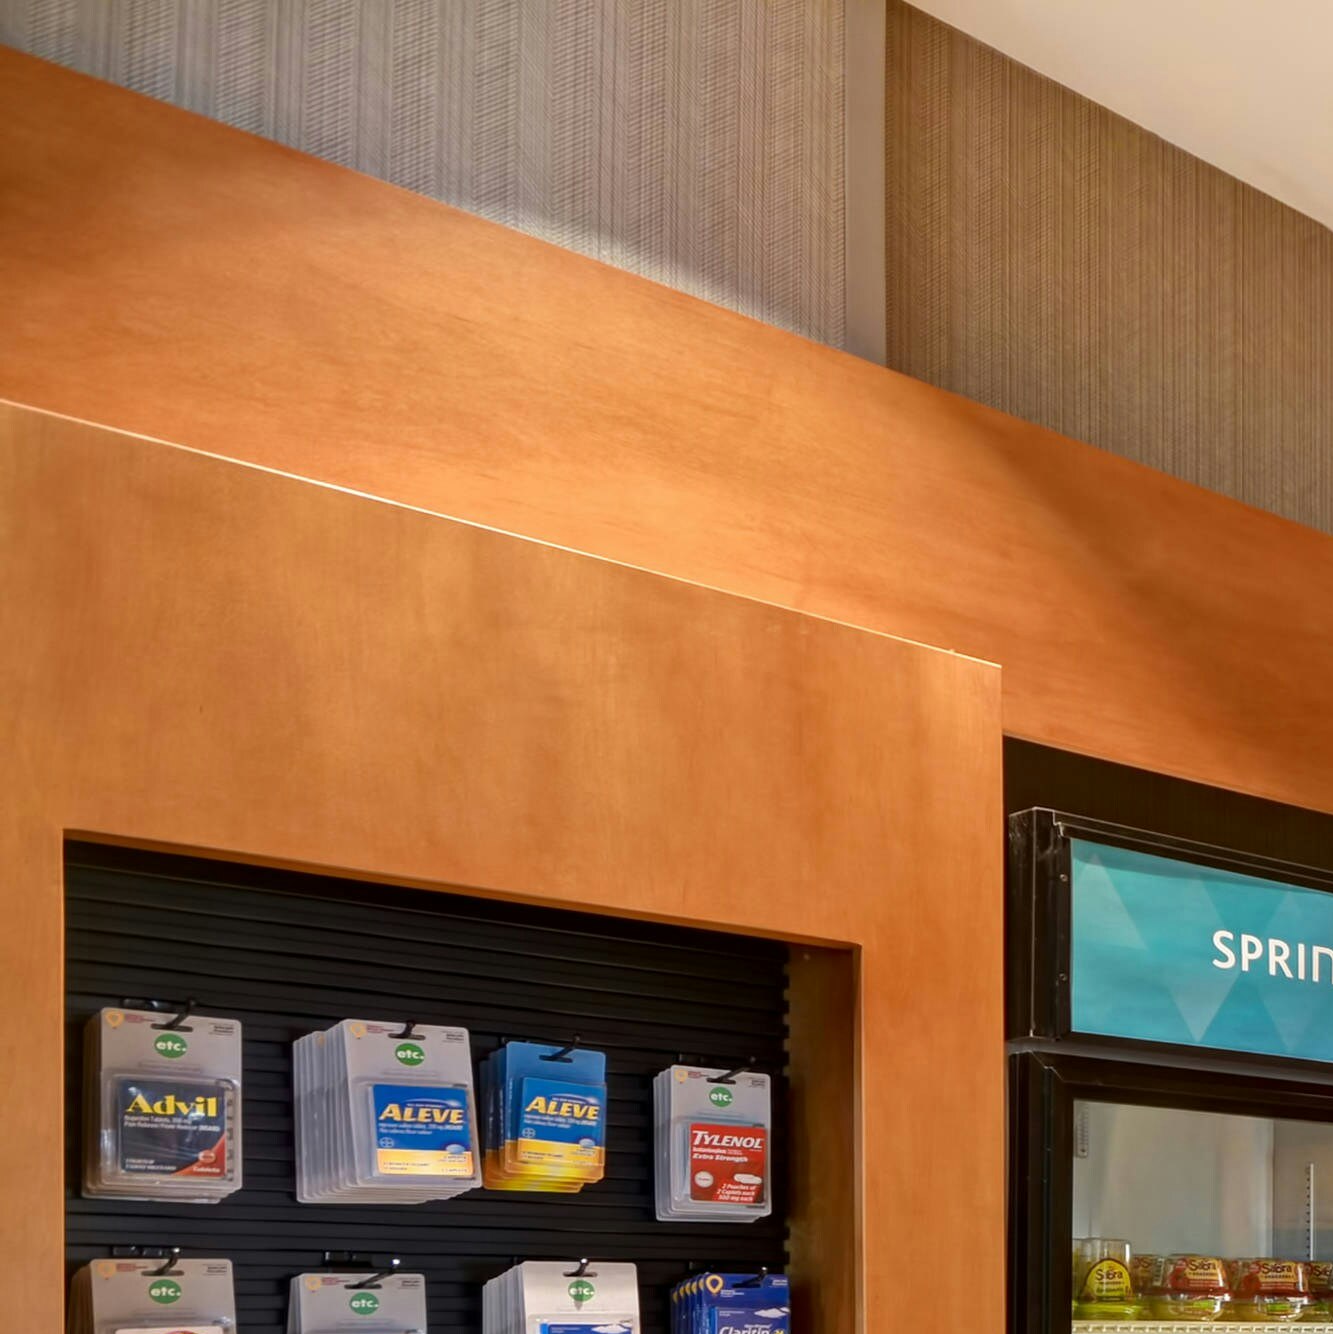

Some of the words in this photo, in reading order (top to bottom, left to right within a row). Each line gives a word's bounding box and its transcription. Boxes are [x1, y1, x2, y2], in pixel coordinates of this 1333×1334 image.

[155, 1039, 187, 1052] etc.
[397, 1048, 425, 1060] etc.
[710, 1091, 734, 1103] etc.
[125, 1094, 217, 1118] Advil
[525, 1095, 599, 1122] ALEVE
[378, 1102, 465, 1125] ALEVE
[692, 1130, 765, 1149] TYLENOL
[150, 1285, 182, 1298] etc.
[568, 1285, 595, 1297] etc.
[351, 1298, 379, 1309] etc.
